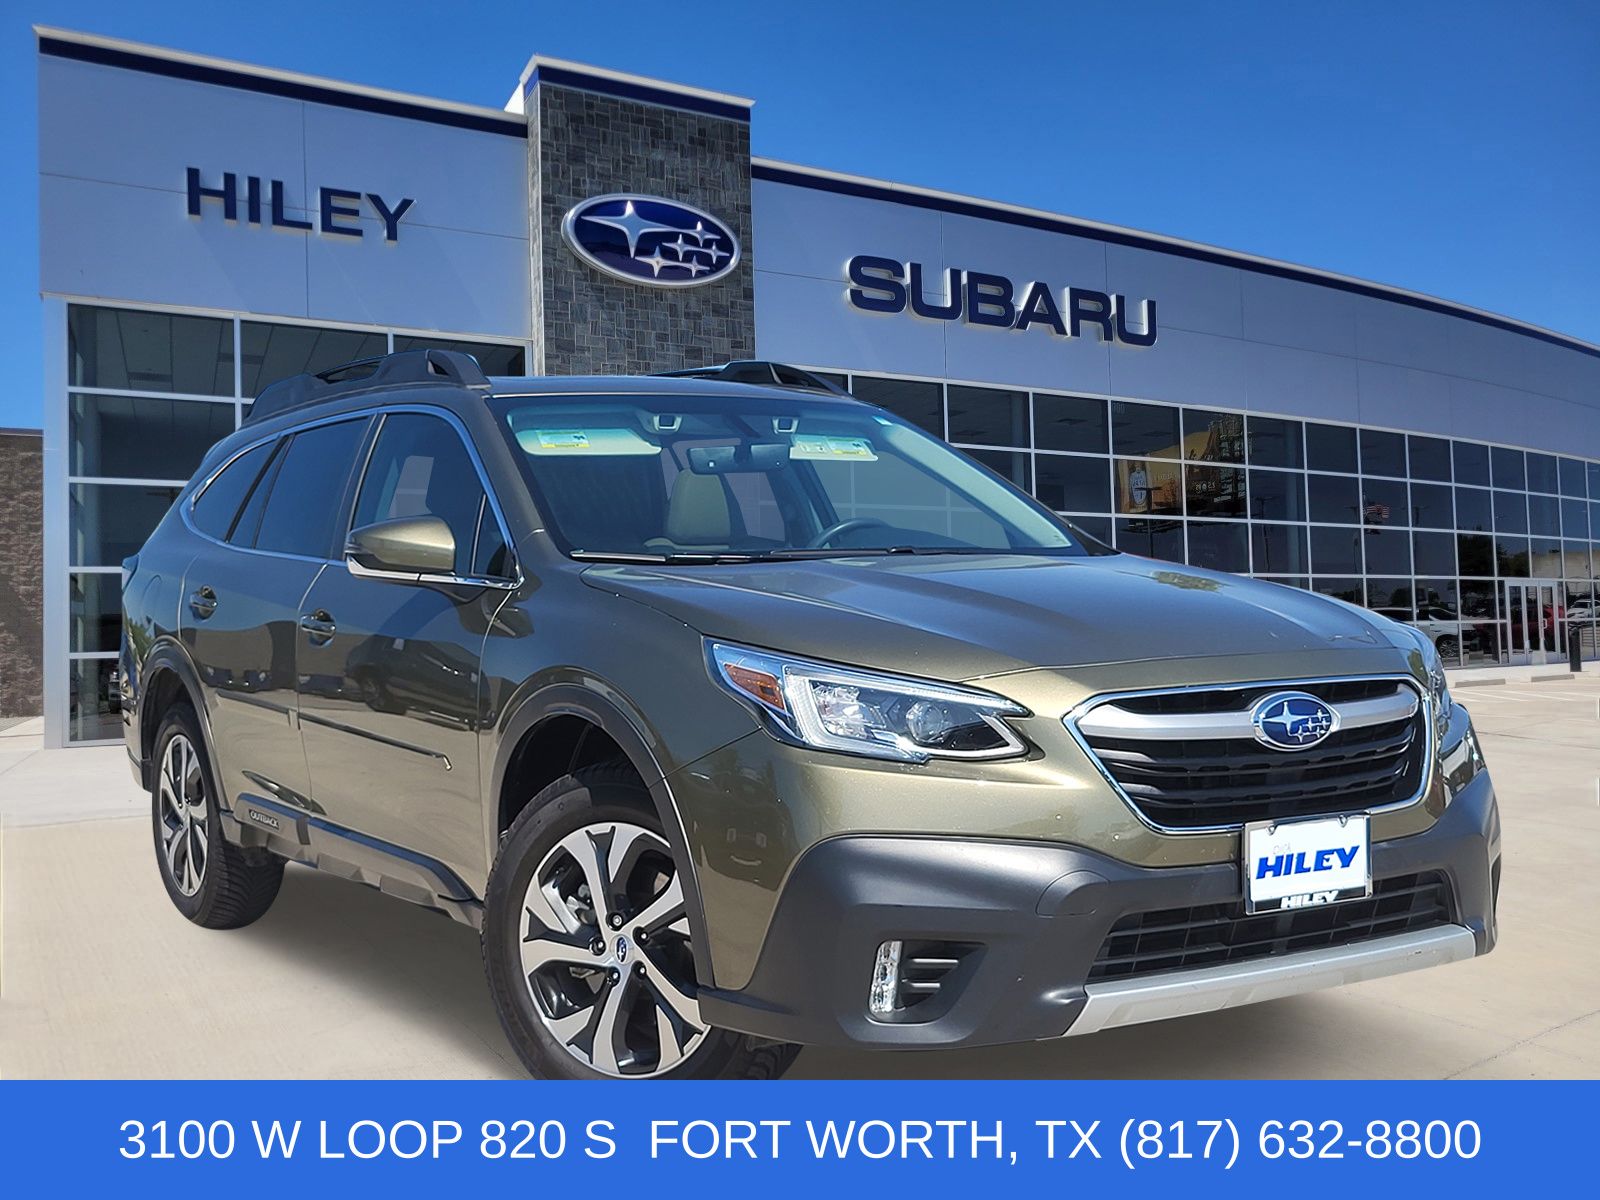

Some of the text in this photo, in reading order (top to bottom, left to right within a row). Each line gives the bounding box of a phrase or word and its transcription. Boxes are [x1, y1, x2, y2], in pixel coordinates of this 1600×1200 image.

[186, 166, 416, 242] HILEY
[847, 254, 1157, 348] SUBARU
[1256, 845, 1360, 879] HILEY
[1280, 889, 1339, 909] HILEY
